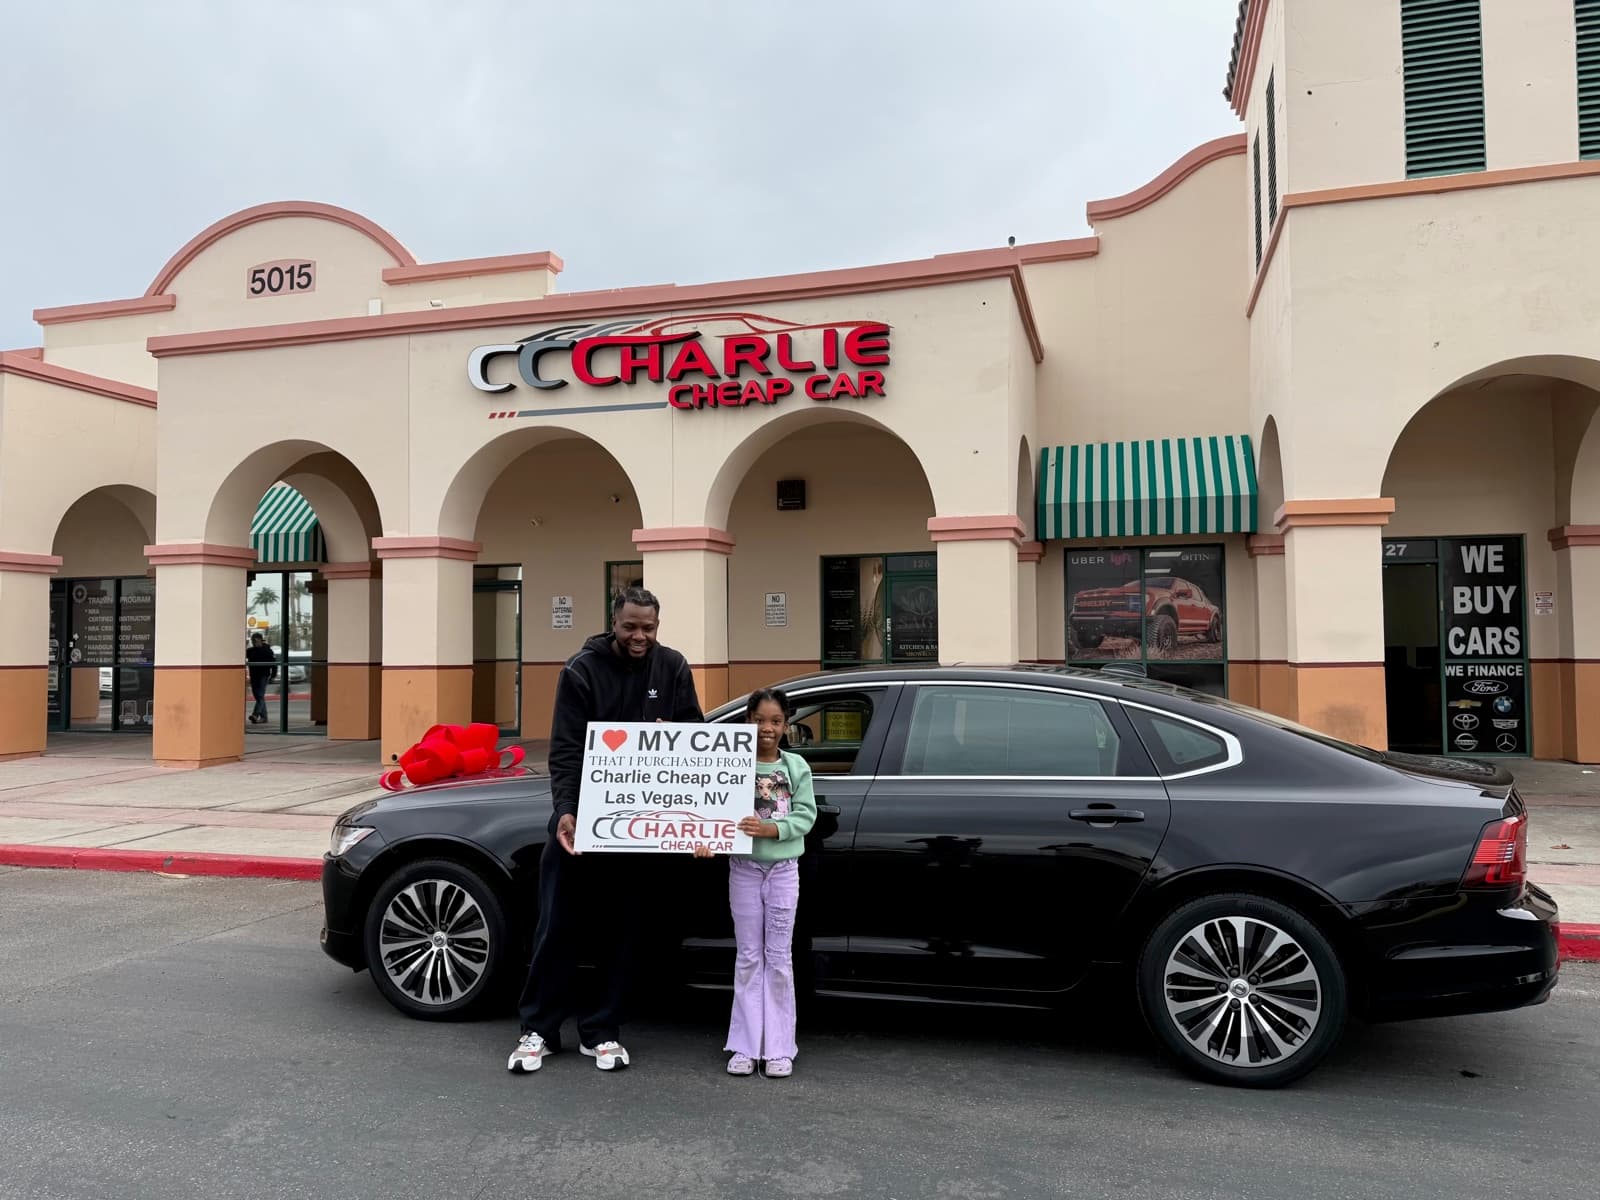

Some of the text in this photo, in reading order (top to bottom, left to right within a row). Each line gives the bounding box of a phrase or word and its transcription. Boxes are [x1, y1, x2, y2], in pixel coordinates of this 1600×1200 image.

[250, 264, 312, 294] 5015
[668, 371, 887, 411] CHEAP CAR
[1071, 556, 1105, 565] UBER
[1460, 545, 1505, 573] WE
[771, 595, 781, 603] NO
[1453, 585, 1517, 615] BUY
[1448, 626, 1521, 656] CARS
[1445, 665, 1524, 676] WE FINANCE
[1471, 681, 1500, 692] Ford
[588, 730, 753, 753] I MY CAR
[589, 756, 752, 768] THAT I PURCHASED FROM
[590, 769, 747, 787] Charlie Cheap Car
[605, 791, 729, 808] Las Vegas, NV
[660, 840, 733, 851] CHEAP CAR
